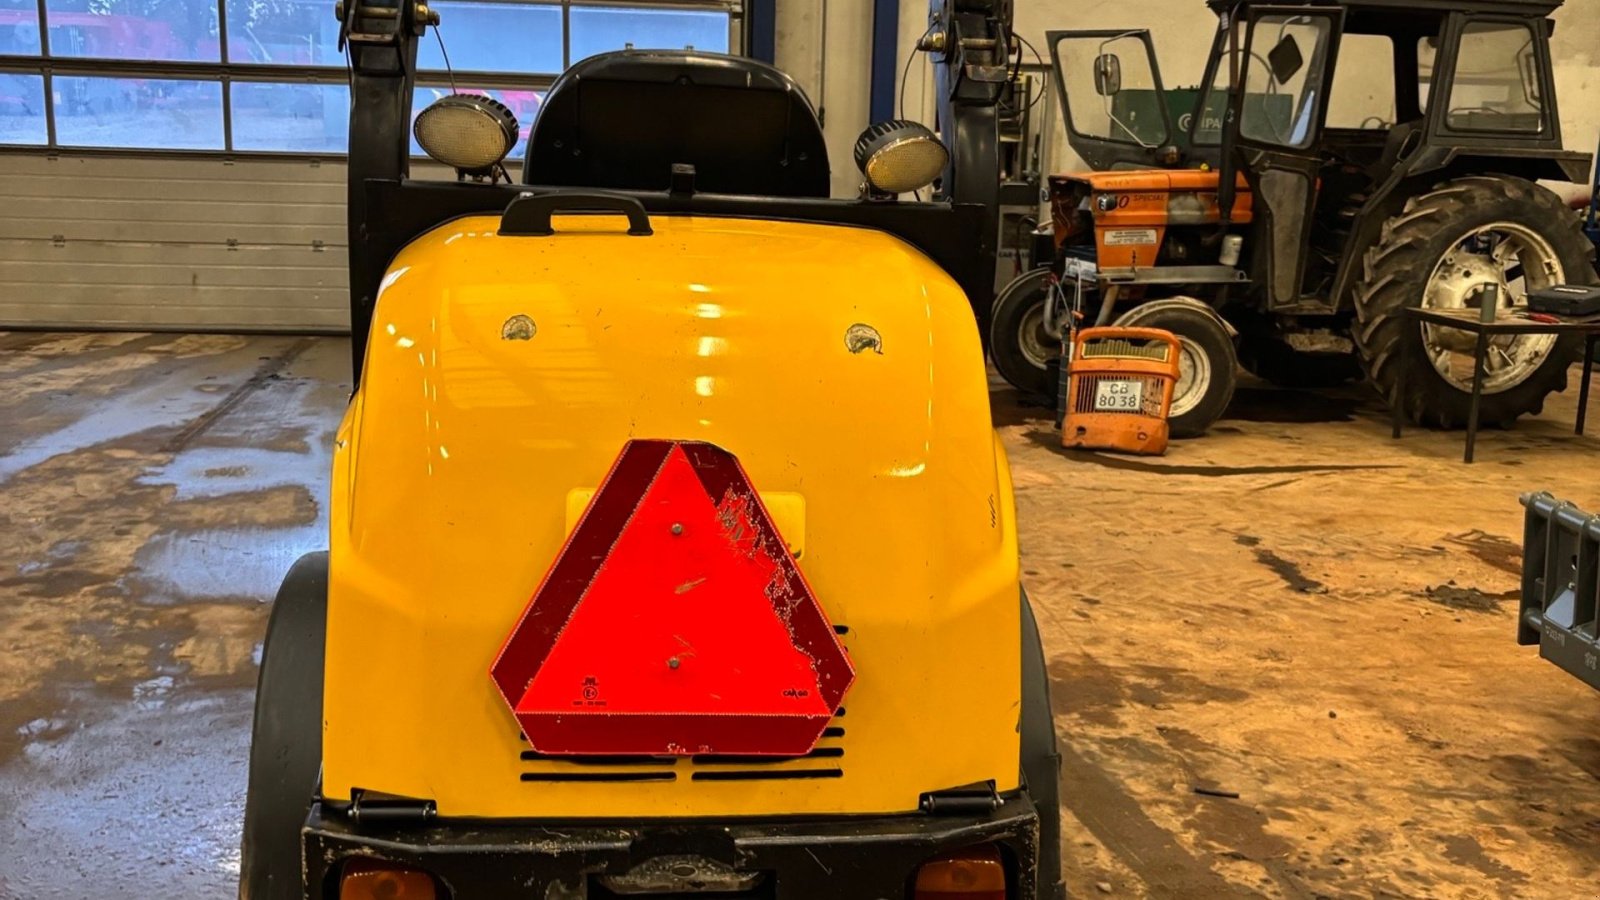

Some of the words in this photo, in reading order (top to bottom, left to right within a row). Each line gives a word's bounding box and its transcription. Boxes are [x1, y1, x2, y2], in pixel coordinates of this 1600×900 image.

[1133, 194, 1166, 202] SPECIAL
[1099, 395, 1116, 407] 80
[1119, 395, 1137, 407] 38
